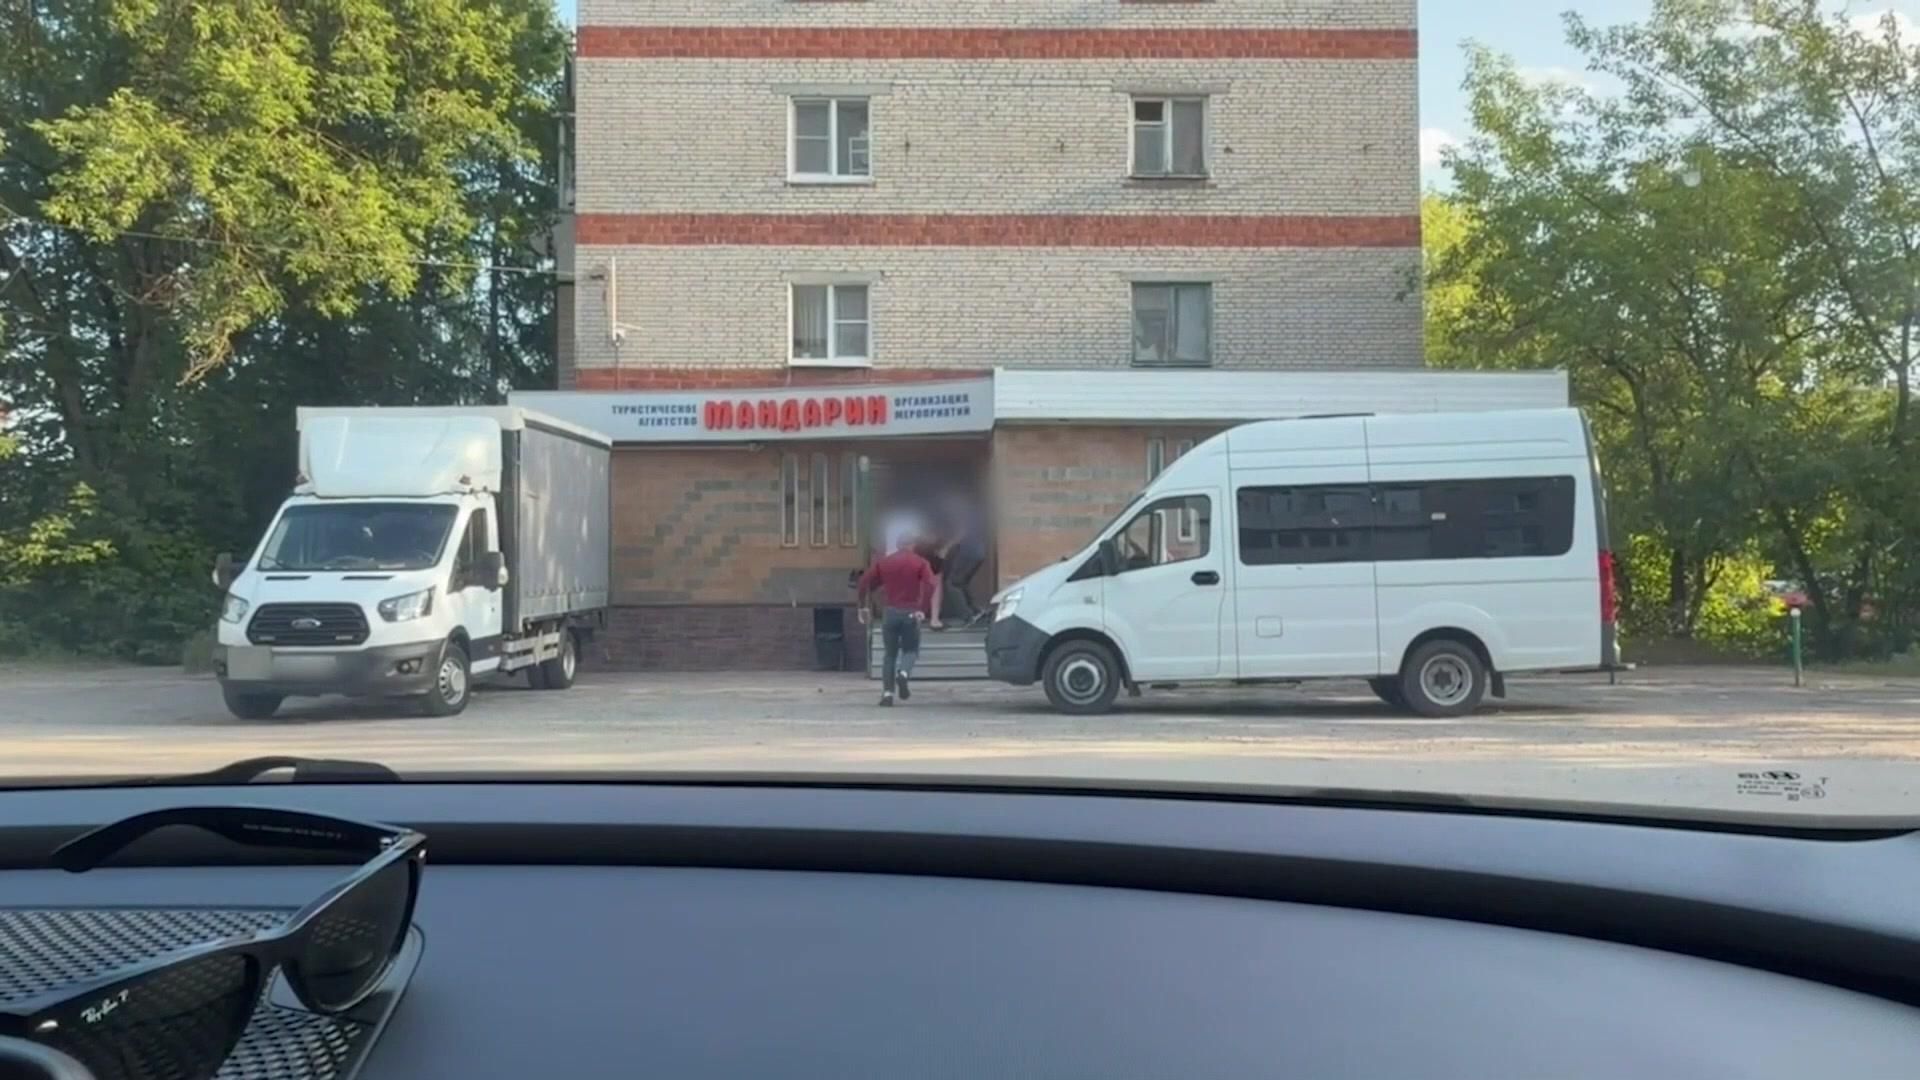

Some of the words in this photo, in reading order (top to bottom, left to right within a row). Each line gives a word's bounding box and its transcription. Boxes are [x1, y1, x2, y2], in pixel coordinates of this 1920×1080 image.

[895, 394, 969, 407] ОРГАНИЗАЦИЯ
[611, 404, 697, 415] ТУРИСТИЧЕСКОЕ
[704, 395, 887, 432] МАНДАРИН
[895, 406, 971, 420] МЕРОПРИЯТИЙ
[638, 416, 698, 427] АГЕНТСТВО
